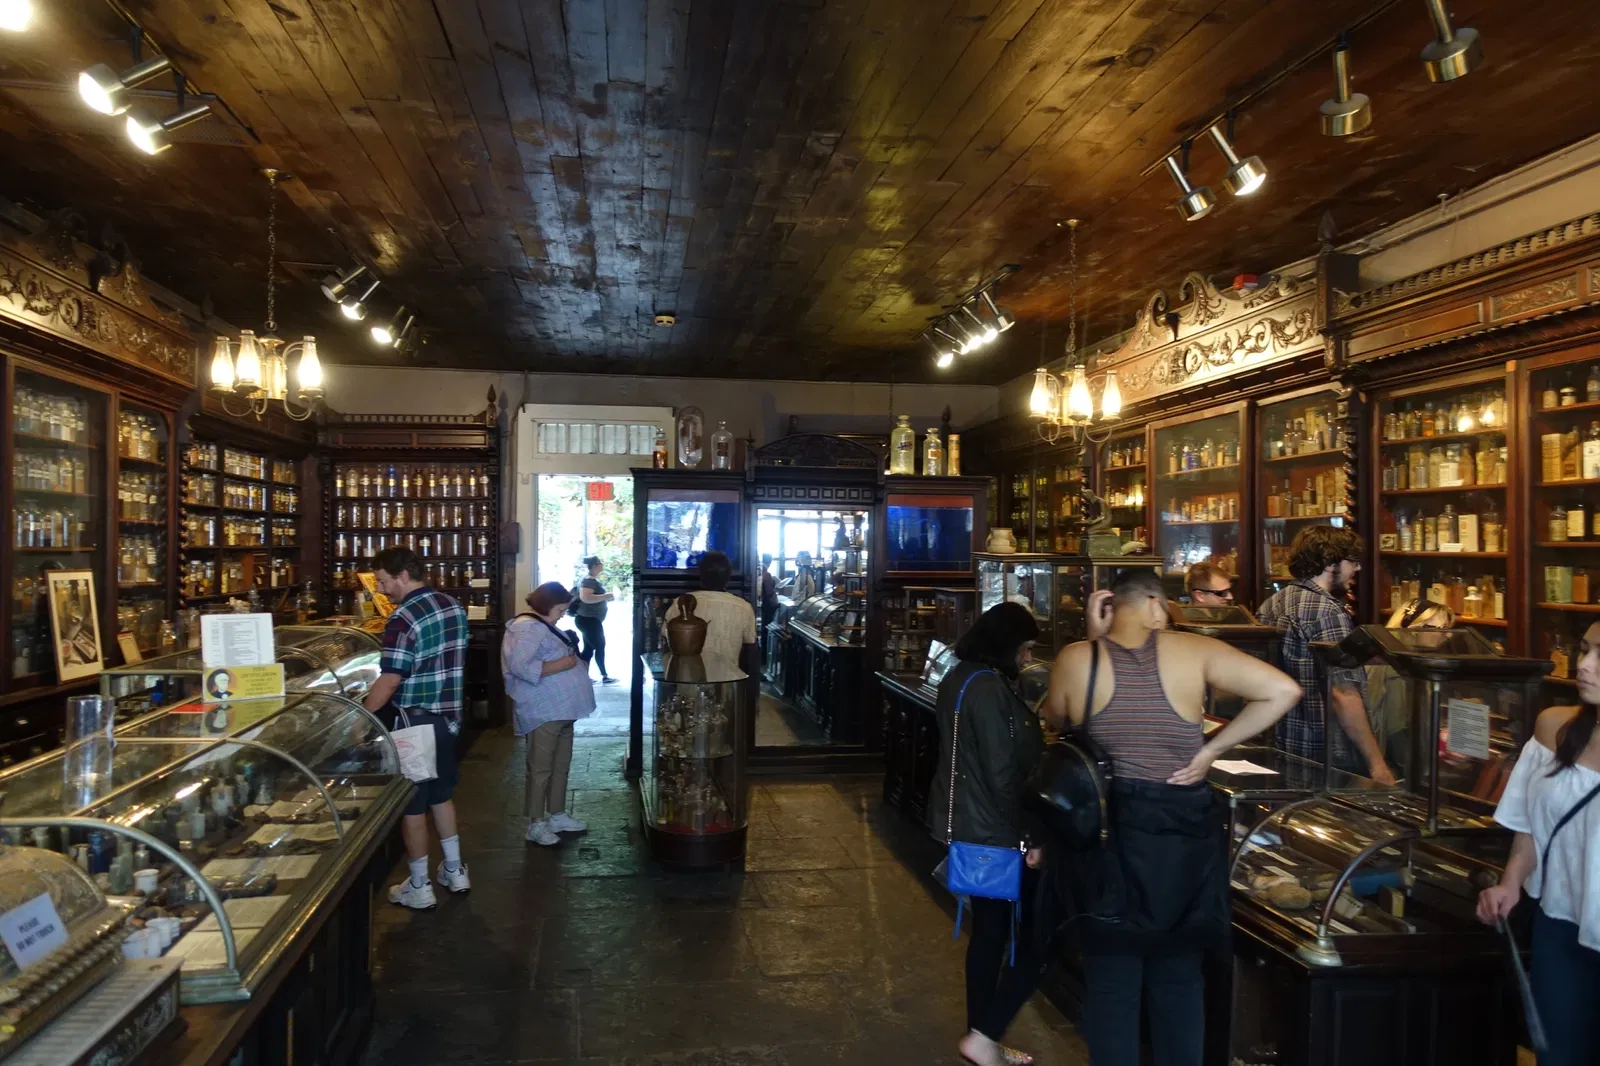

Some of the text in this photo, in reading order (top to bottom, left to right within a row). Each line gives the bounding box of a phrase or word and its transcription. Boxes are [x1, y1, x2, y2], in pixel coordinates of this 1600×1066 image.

[19, 917, 39, 933] PLEASE
[16, 923, 55, 952] DO NOT TOUCH
